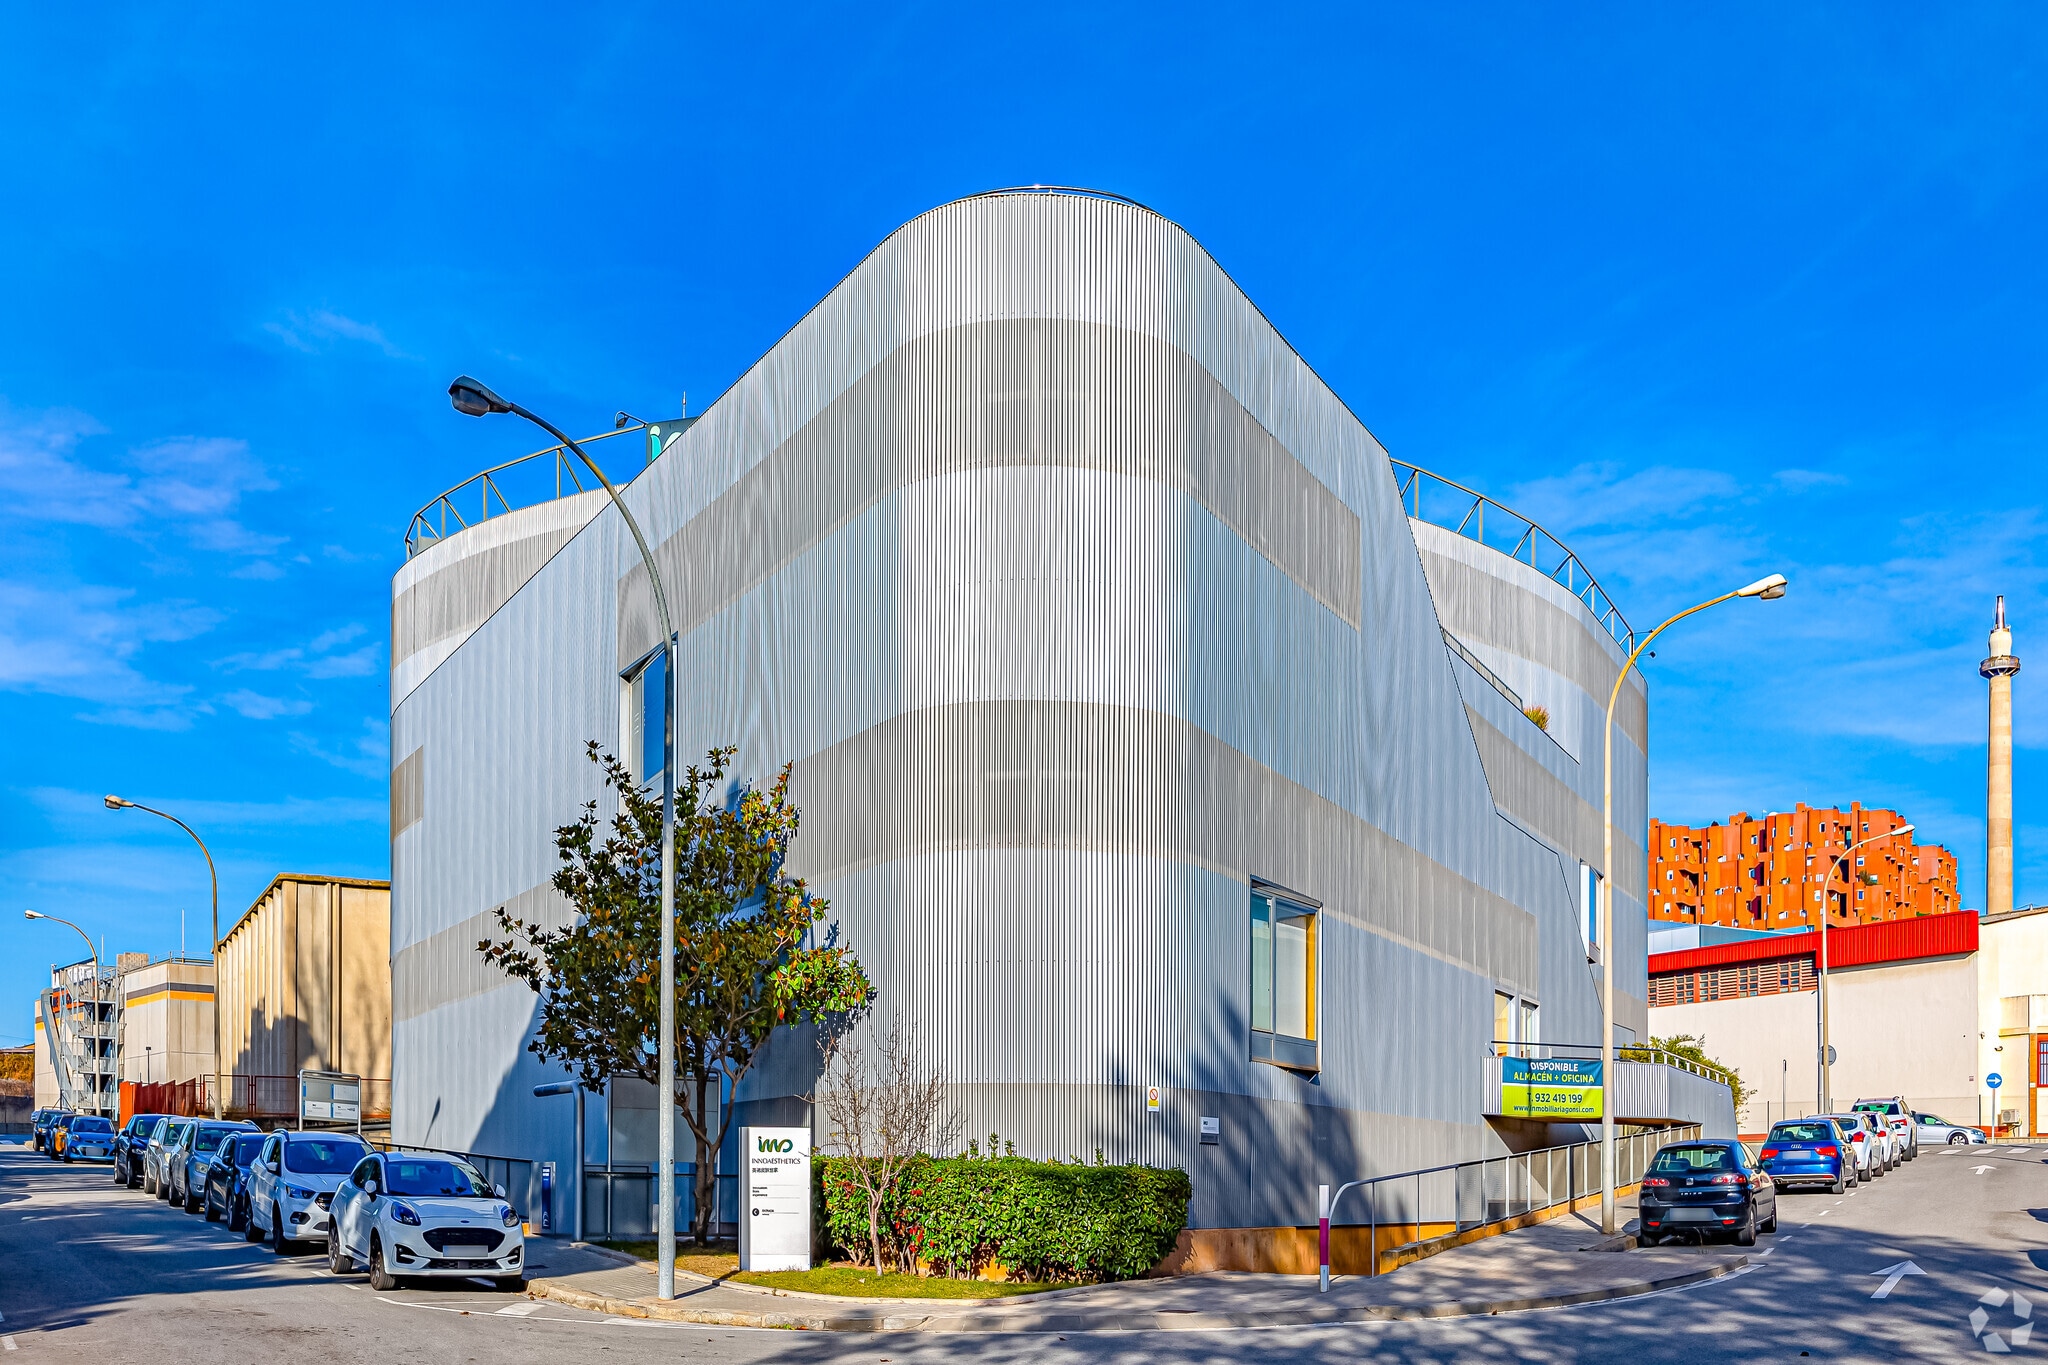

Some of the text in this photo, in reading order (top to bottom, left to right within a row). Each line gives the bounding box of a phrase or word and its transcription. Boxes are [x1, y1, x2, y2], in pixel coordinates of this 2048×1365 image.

[1530, 1062, 1578, 1072] DISPONIBLE
[1514, 1071, 1552, 1082] ALMACÉN
[1561, 1074, 1595, 1083] OFICINA
[1535, 1093, 1550, 1103] 932
[1552, 1094, 1567, 1103] 419
[1568, 1094, 1583, 1103] 199
[751, 1157, 801, 1165] INNOAESTHETICS
